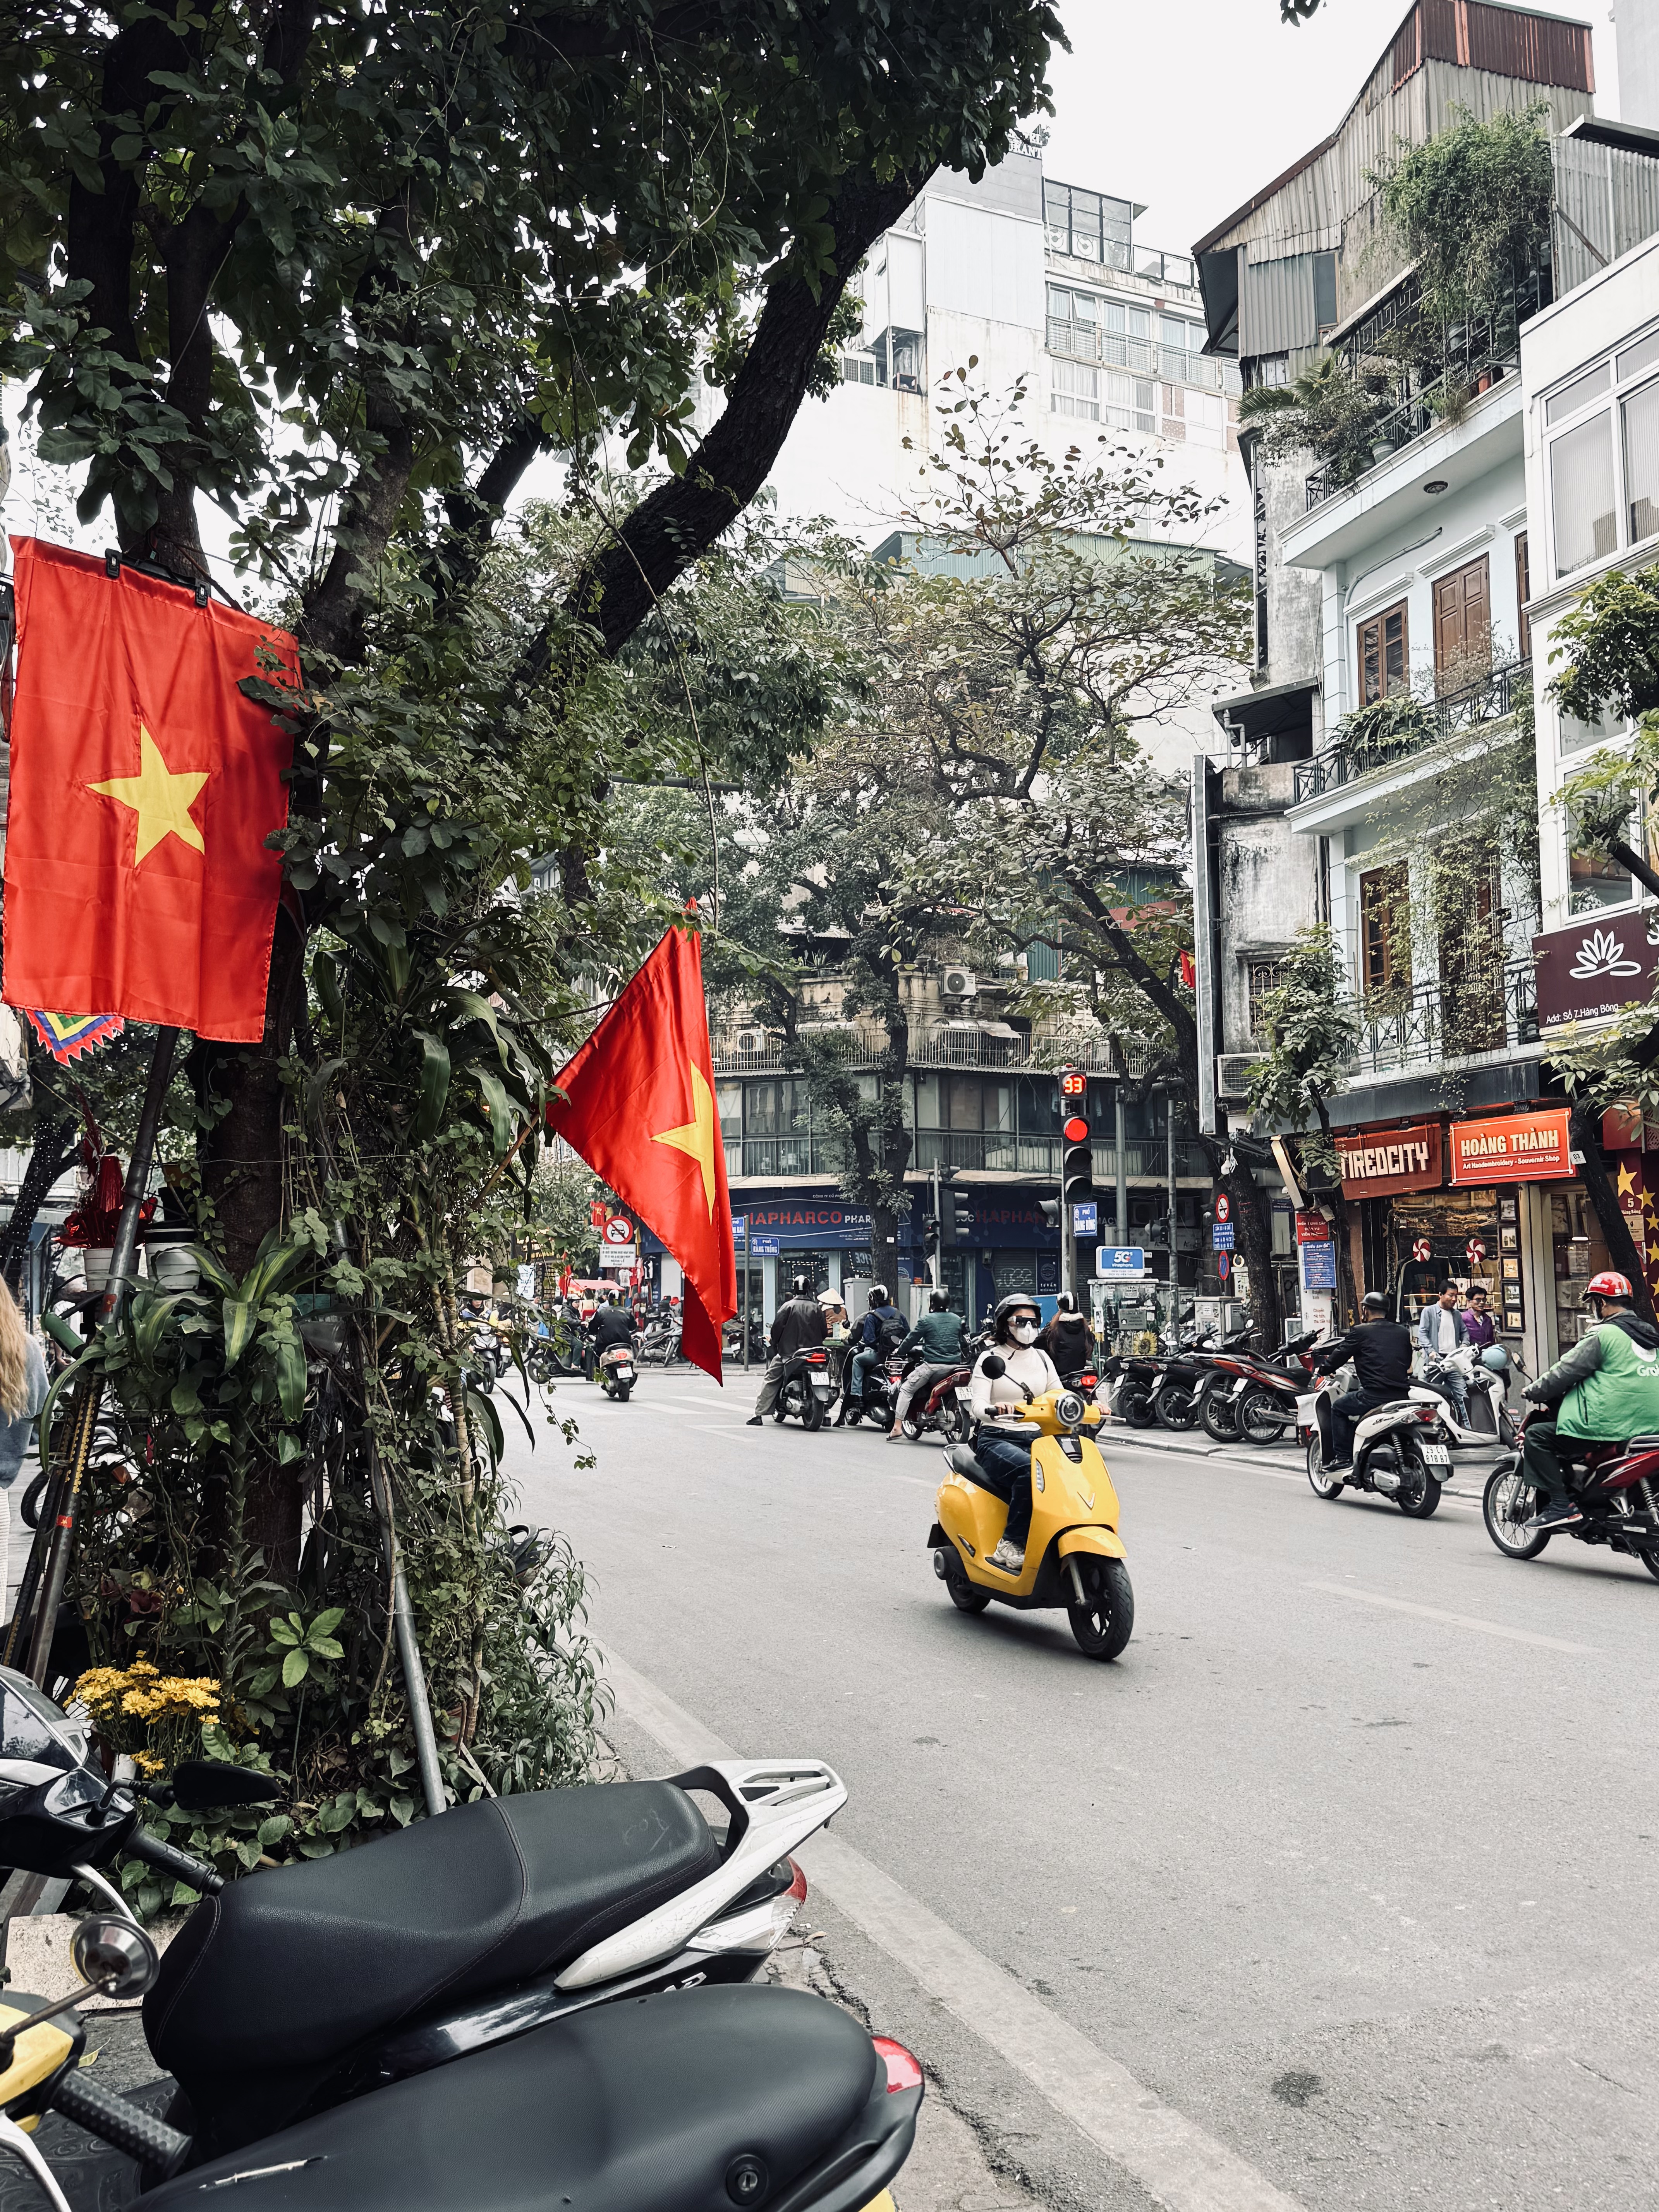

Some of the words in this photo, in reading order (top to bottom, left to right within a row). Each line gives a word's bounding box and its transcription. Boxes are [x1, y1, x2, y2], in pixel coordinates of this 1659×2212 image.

[1546, 1013, 1562, 1024] Add:
[1563, 1009, 1573, 1021] Số
[1580, 1007, 1598, 1017] Hàng
[1600, 1003, 1619, 1013] Bông
[1461, 1133, 1506, 1156] HOÀNG
[1510, 1127, 1559, 1151] THÀNH
[1339, 1141, 1429, 1179] TIREDCITY
[1627, 1197, 1634, 1208] 5
[1113, 1251, 1130, 1263] 5G
